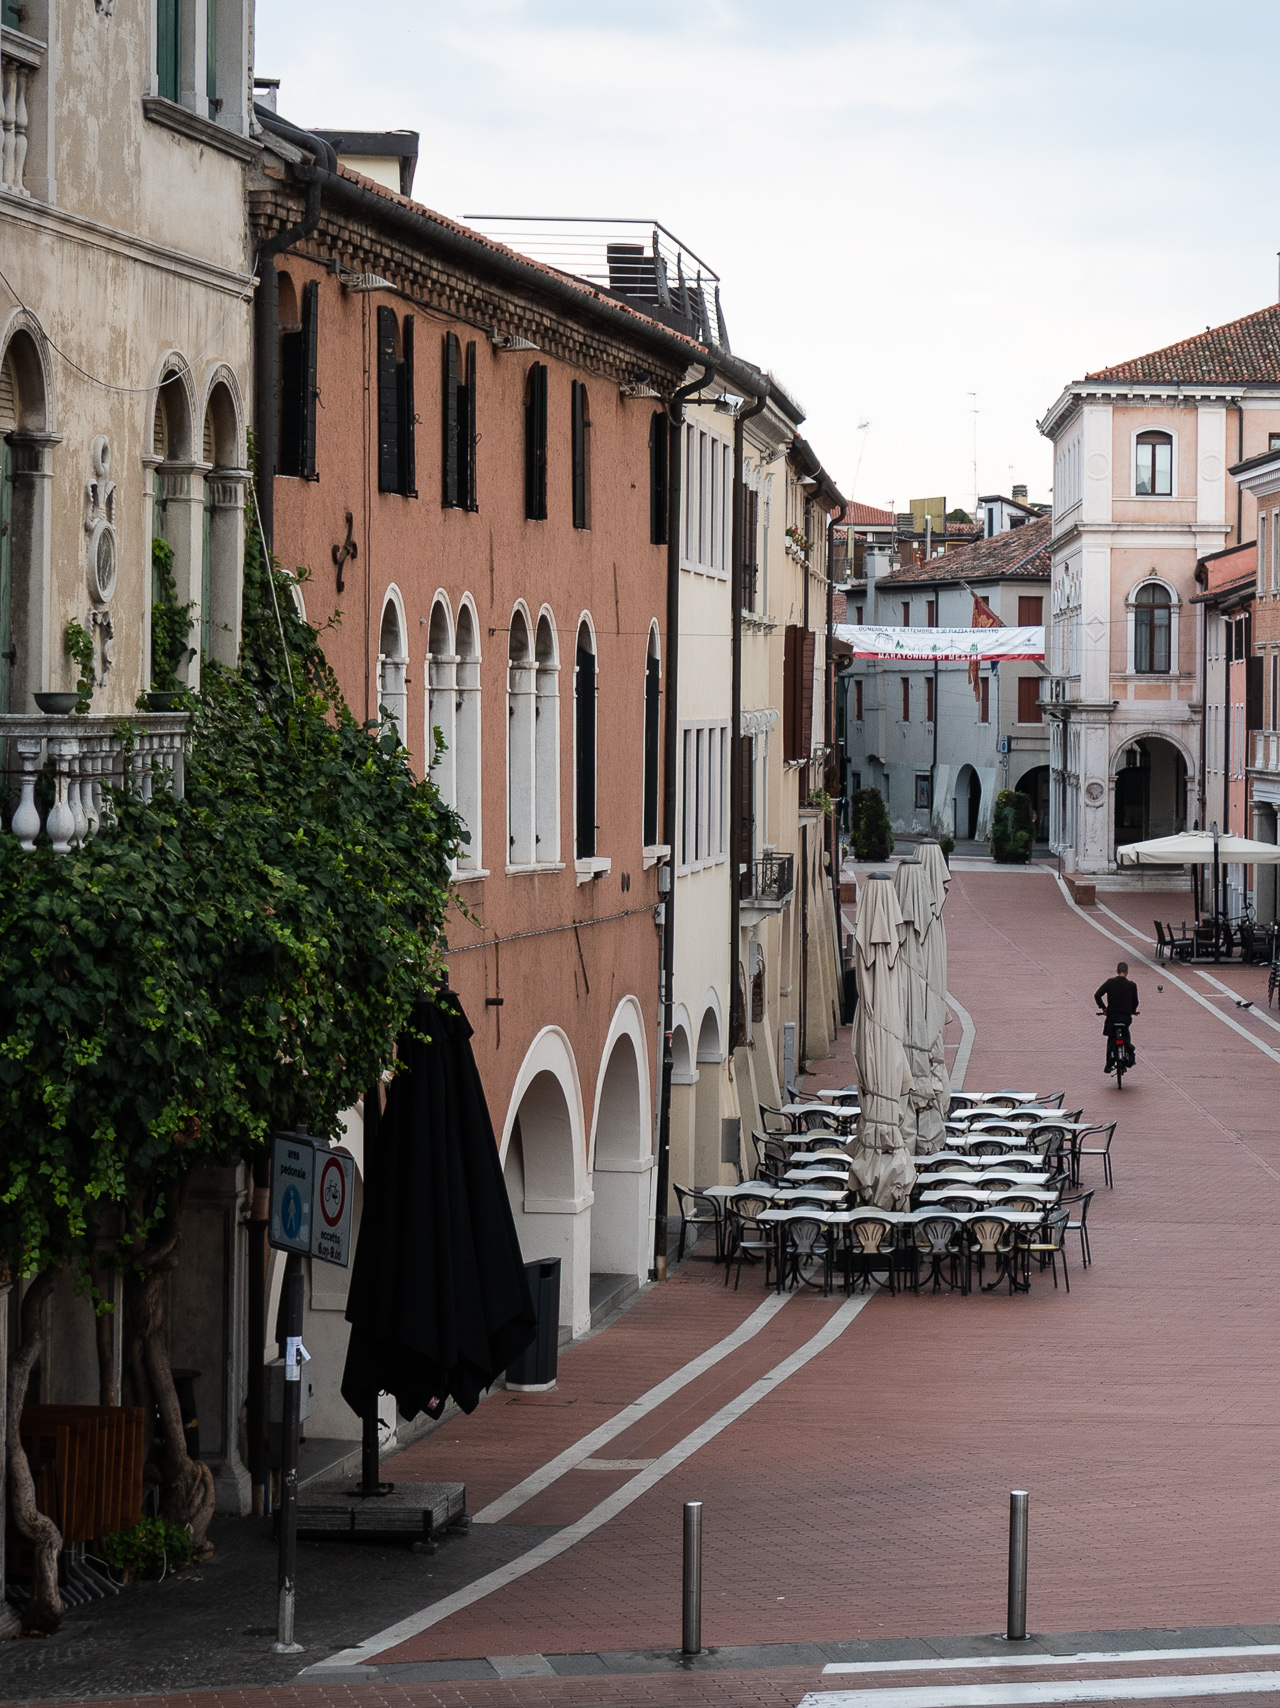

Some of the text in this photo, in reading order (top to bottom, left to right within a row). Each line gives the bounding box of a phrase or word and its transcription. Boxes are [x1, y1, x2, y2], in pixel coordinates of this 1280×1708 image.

[877, 652, 934, 660] MARATONINA
[287, 1149, 300, 1160] area
[280, 1164, 306, 1180] pedonale
[321, 1231, 341, 1244] eccetto
